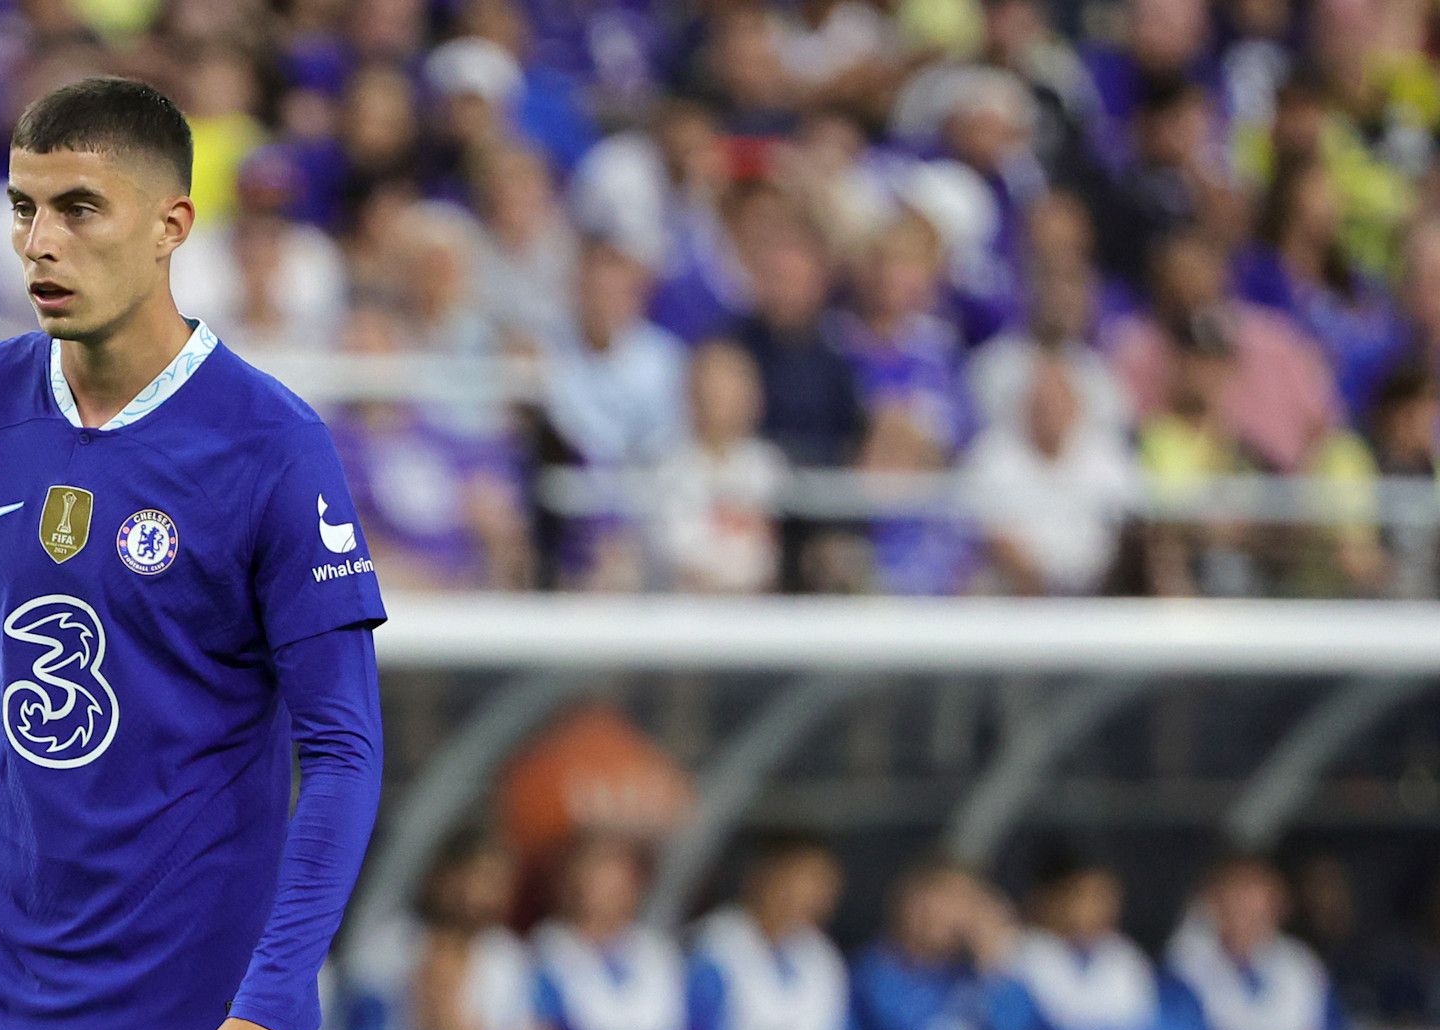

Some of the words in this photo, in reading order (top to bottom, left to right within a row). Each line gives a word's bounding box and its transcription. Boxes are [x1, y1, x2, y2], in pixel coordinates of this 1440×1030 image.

[133, 512, 172, 531] CHELSEA
[51, 532, 73, 545] FIFA
[2, 594, 120, 769] 3
